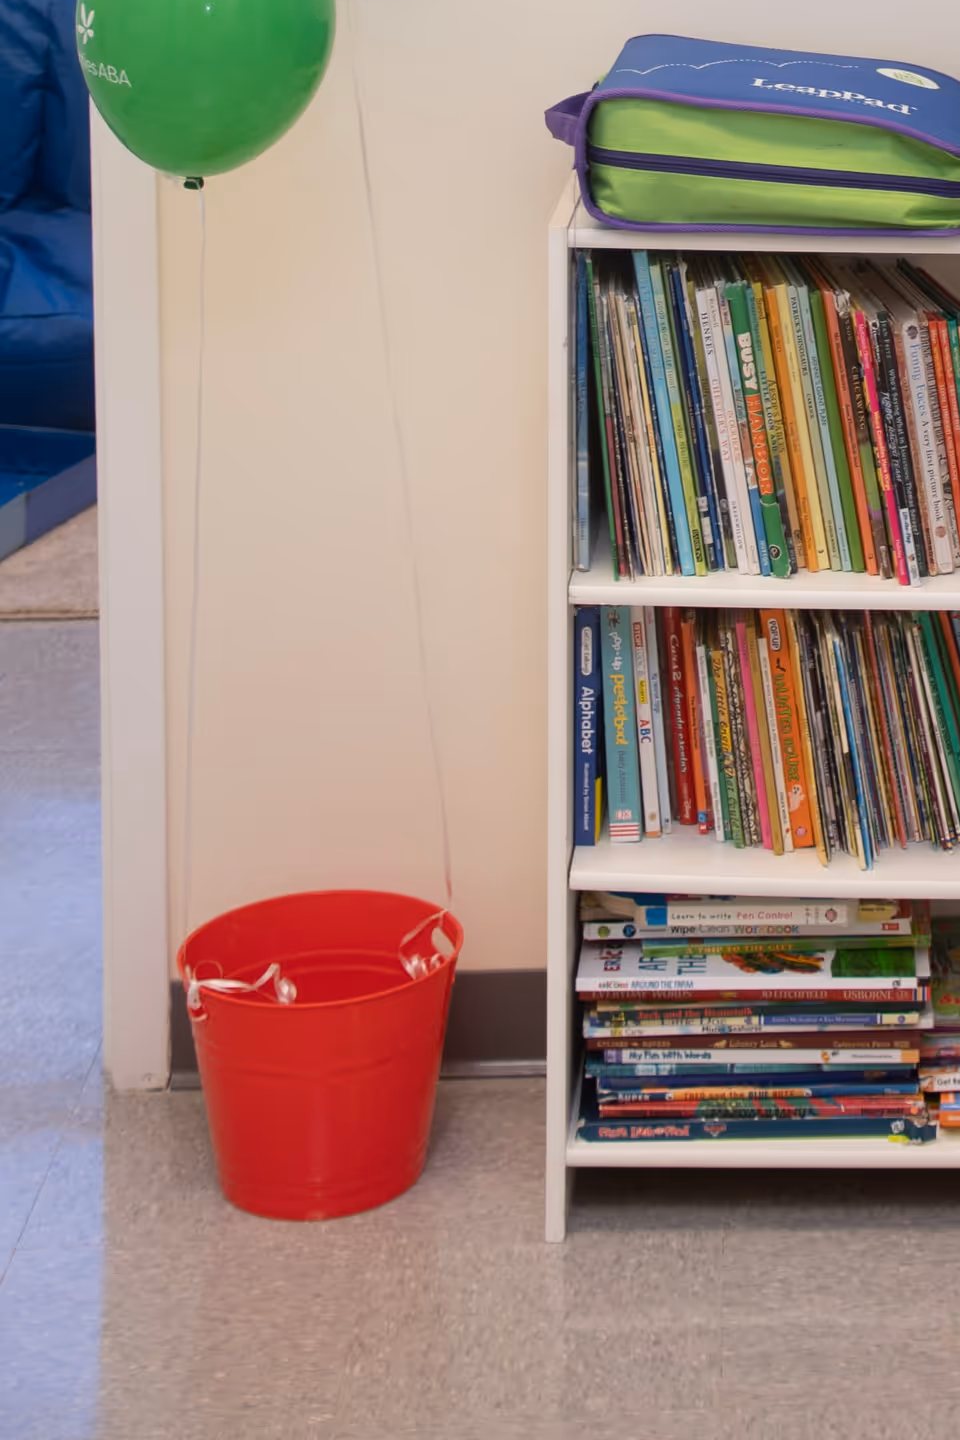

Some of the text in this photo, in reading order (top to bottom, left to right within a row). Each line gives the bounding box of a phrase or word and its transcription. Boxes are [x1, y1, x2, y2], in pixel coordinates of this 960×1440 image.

[749, 78, 912, 115] LeapPad
[791, 296, 807, 376] PATRICK'S DINOSAURS
[880, 320, 889, 338] JEAN
[700, 312, 714, 356] HENKES
[710, 378, 729, 434] CHESTER'S
[737, 331, 759, 390] BUSY
[760, 371, 771, 403] LITTLE
[889, 369, 897, 391] Who's
[851, 366, 867, 430] CRICKWING
[915, 384, 928, 417] Faces
[896, 416, 905, 435] What
[922, 429, 931, 447] very
[745, 393, 774, 495] HARBOR
[899, 436, 906, 444] in
[925, 450, 935, 467] first
[905, 482, 915, 508] Thomas
[927, 470, 940, 499] picture
[933, 500, 943, 522] book
[608, 632, 623, 670] pop-up
[578, 686, 596, 754] Alphabet
[639, 719, 652, 744] ABC
[783, 738, 799, 782] HOUSE
[757, 911, 793, 920] Control
[670, 925, 696, 935] Wipe
[843, 990, 893, 999] USBORNE
[628, 1051, 643, 1060] My
[644, 1050, 660, 1059] Fun
[937, 1078, 951, 1086] Get
